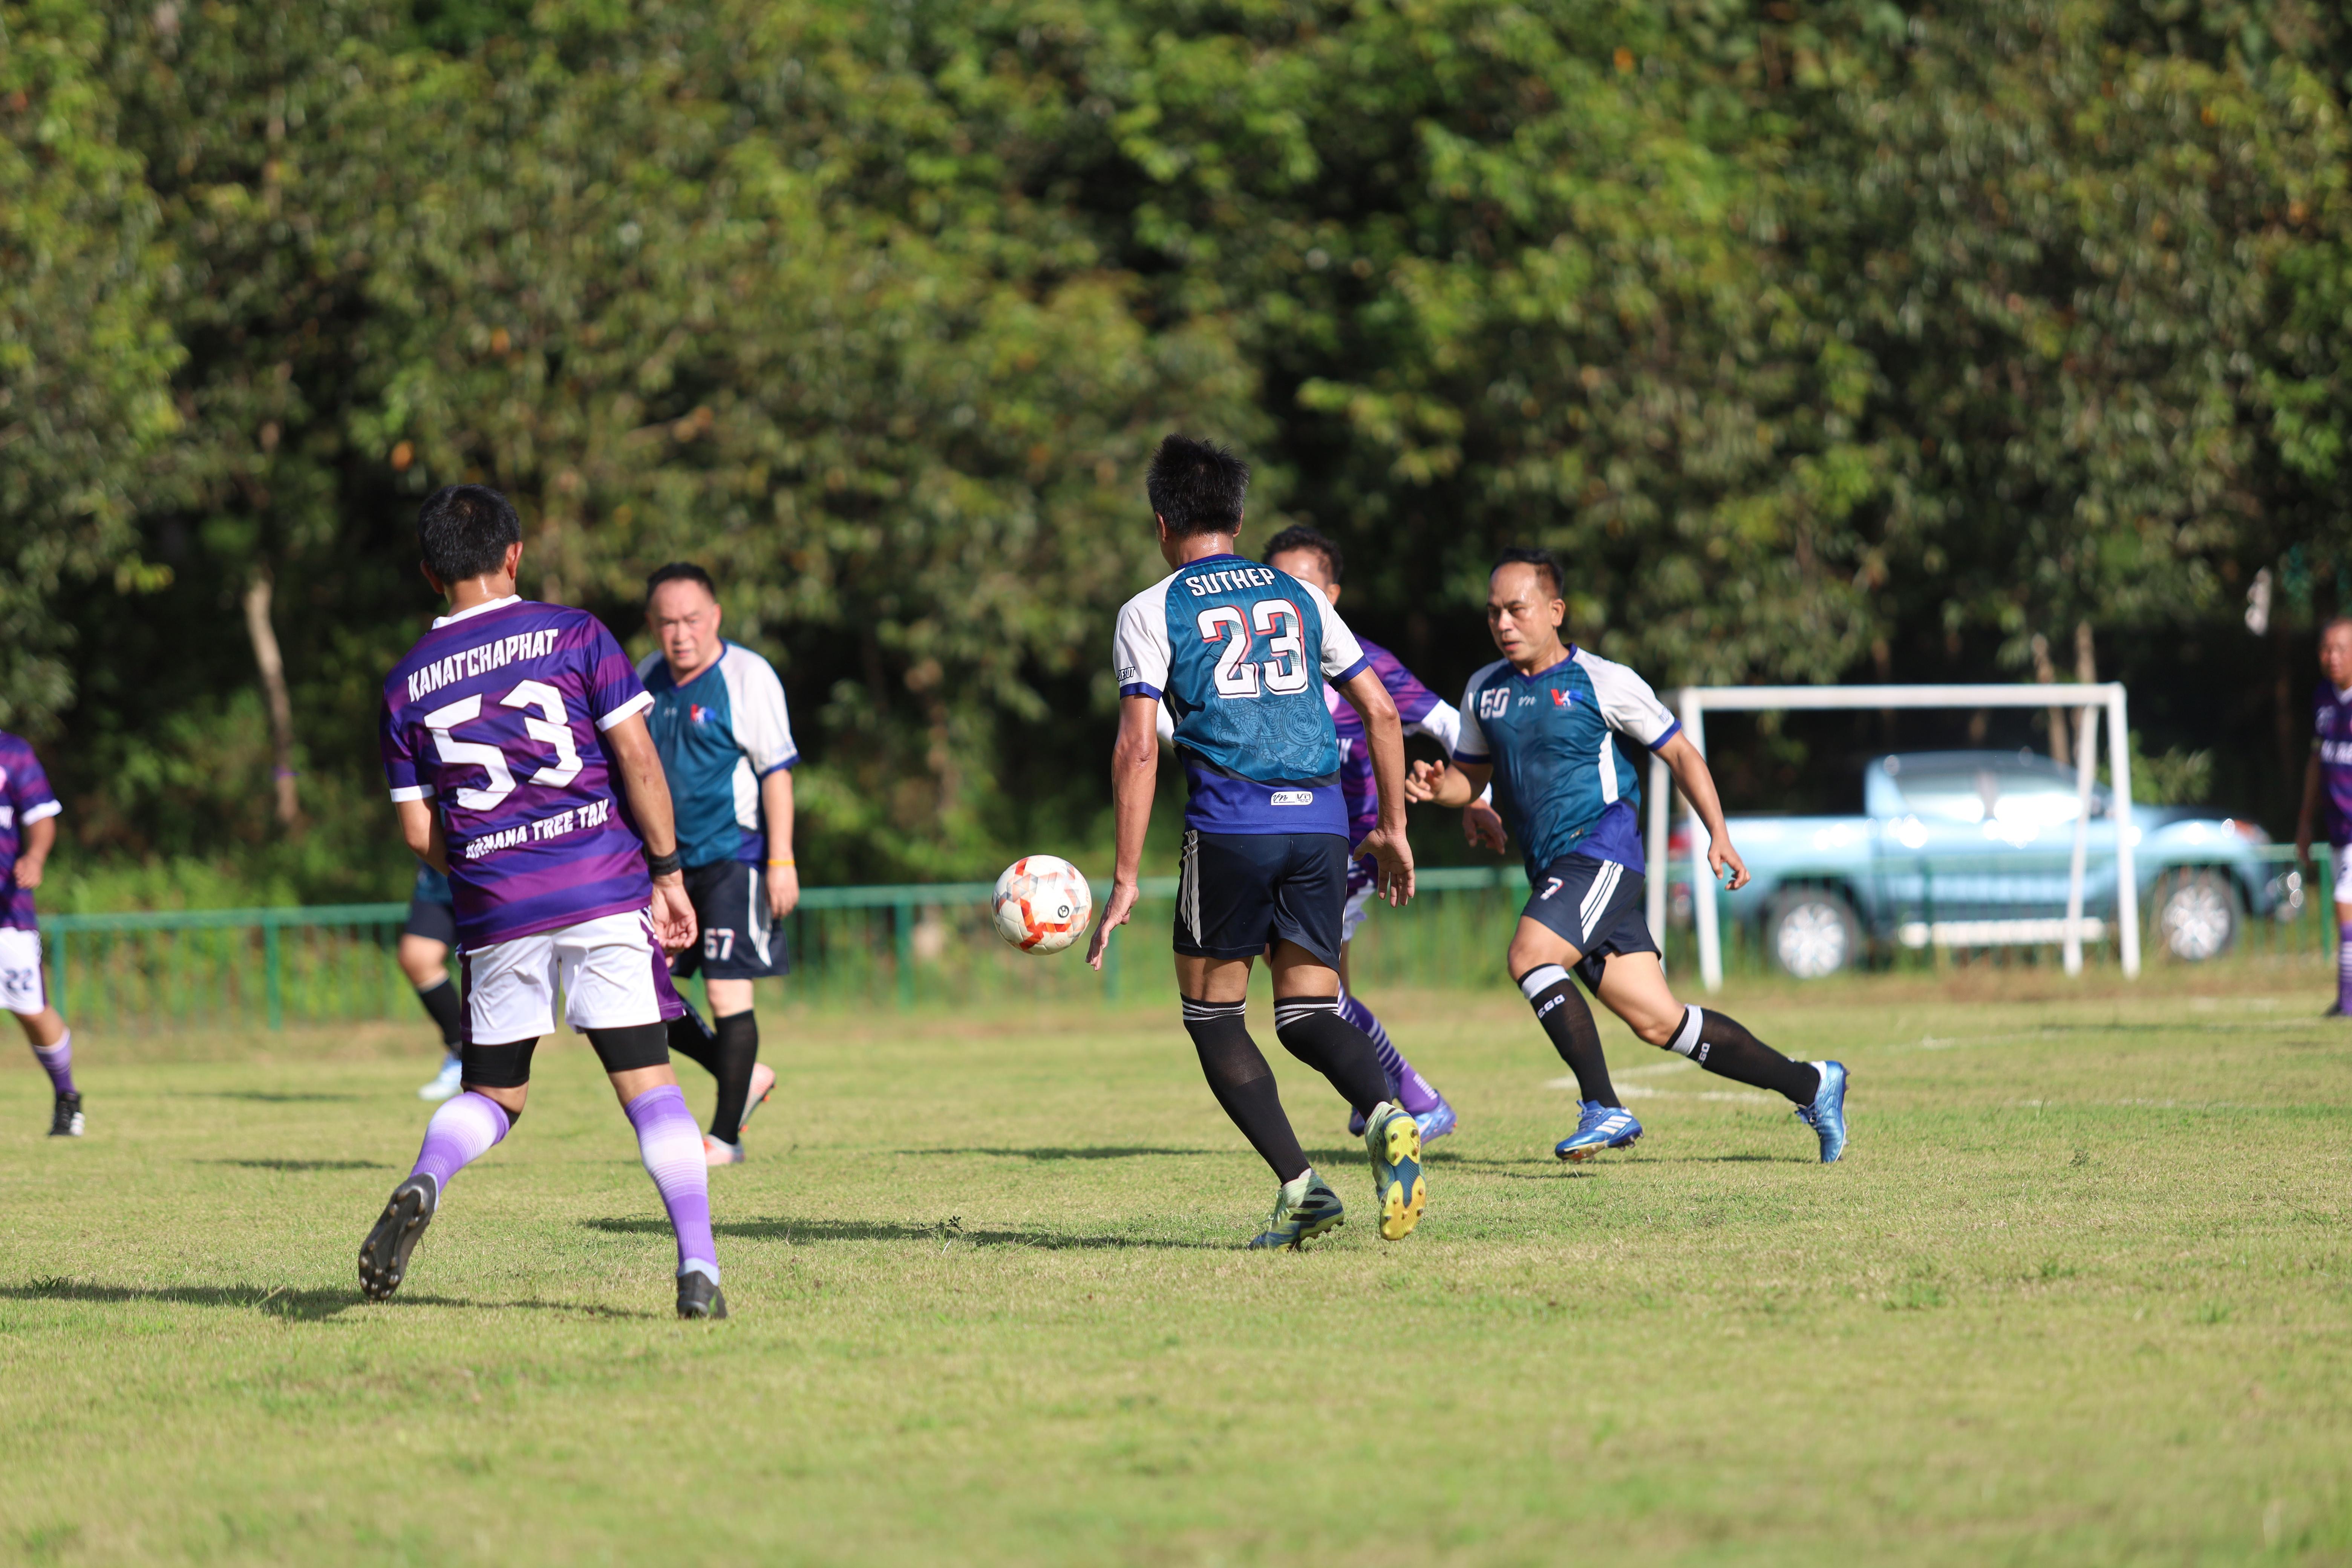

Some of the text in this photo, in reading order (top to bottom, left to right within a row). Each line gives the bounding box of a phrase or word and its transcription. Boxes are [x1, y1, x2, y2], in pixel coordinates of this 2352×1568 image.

[1185, 568, 1276, 597] SUTHEP
[407, 628, 559, 702] KANATCHAPHAT
[1196, 598, 1308, 699] 23
[1117, 666, 1135, 682] AESOT
[1480, 687, 1510, 719] 50
[424, 680, 583, 811] 53
[531, 810, 574, 841] TREE
[577, 798, 609, 829] TAK
[704, 928, 735, 961] 57
[1537, 994, 1565, 1019] EGO
